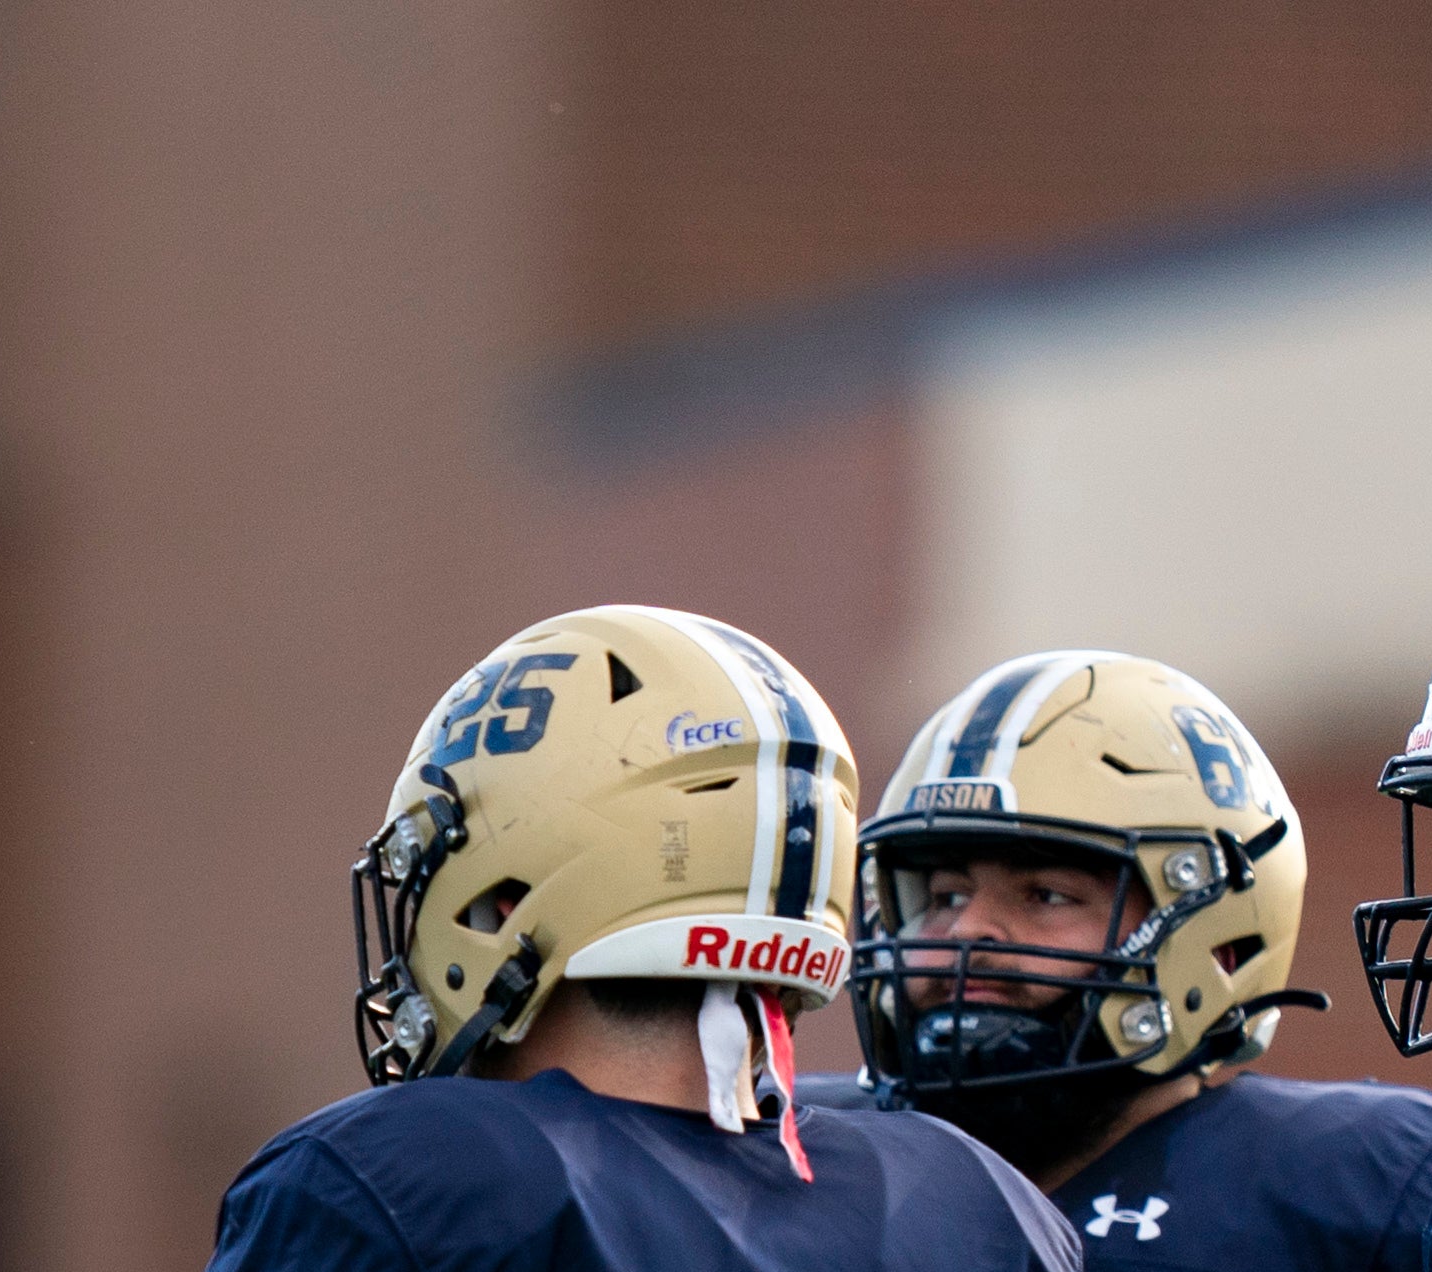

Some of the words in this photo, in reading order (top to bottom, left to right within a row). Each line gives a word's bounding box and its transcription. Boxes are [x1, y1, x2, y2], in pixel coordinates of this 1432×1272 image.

[429, 653, 579, 769] 25
[683, 719, 742, 747] ECFC
[913, 784, 995, 811] BISON
[683, 925, 845, 988] Riddell
